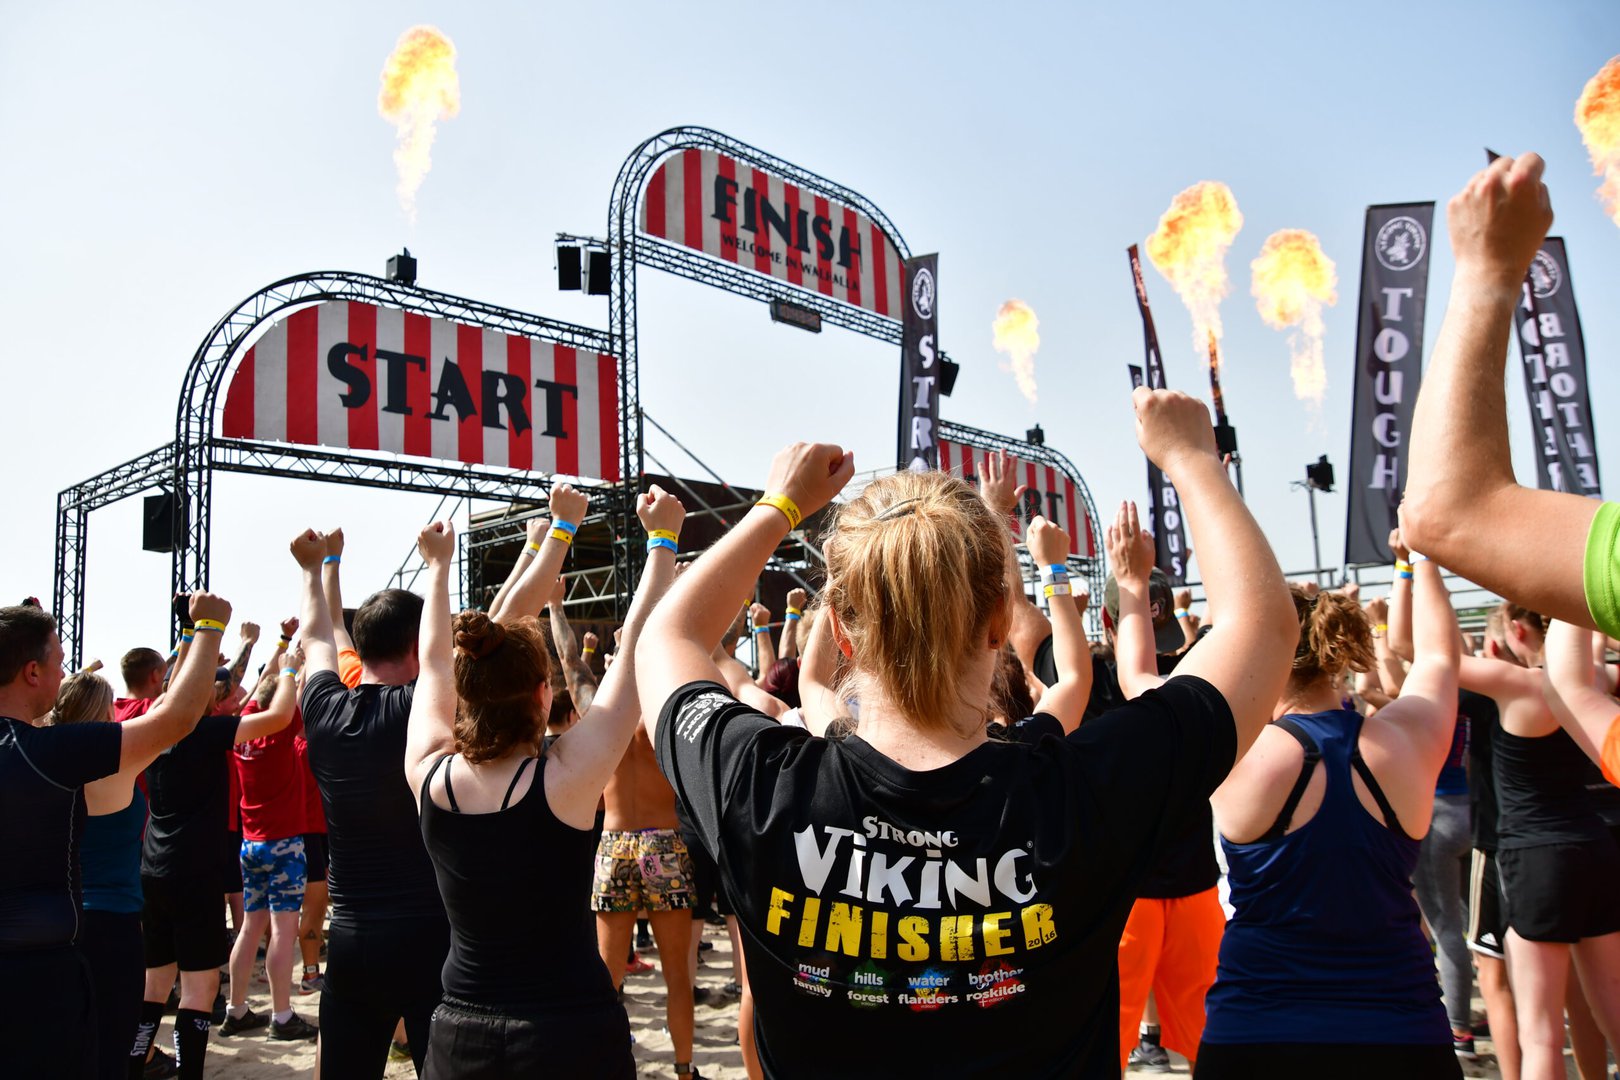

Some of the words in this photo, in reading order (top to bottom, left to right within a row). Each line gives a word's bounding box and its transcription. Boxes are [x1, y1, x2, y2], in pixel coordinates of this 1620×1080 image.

[711, 174, 863, 274] FINISH
[722, 233, 782, 264] WELCOME
[785, 255, 798, 269] IN
[800, 262, 859, 291] WALHALLA
[327, 342, 578, 439] START
[1368, 287, 1413, 489] TOUGH
[862, 815, 959, 848] STRONG
[766, 886, 1058, 962] FINISHER
[798, 962, 831, 978] mud
[854, 971, 884, 986] hills
[968, 967, 1024, 985] brother
[793, 977, 832, 998] family
[908, 975, 950, 987] water
[847, 990, 890, 1004] forest
[898, 993, 959, 1005] flanders
[966, 983, 1026, 1002] roskilde
[130, 1021, 155, 1056] STRONG
